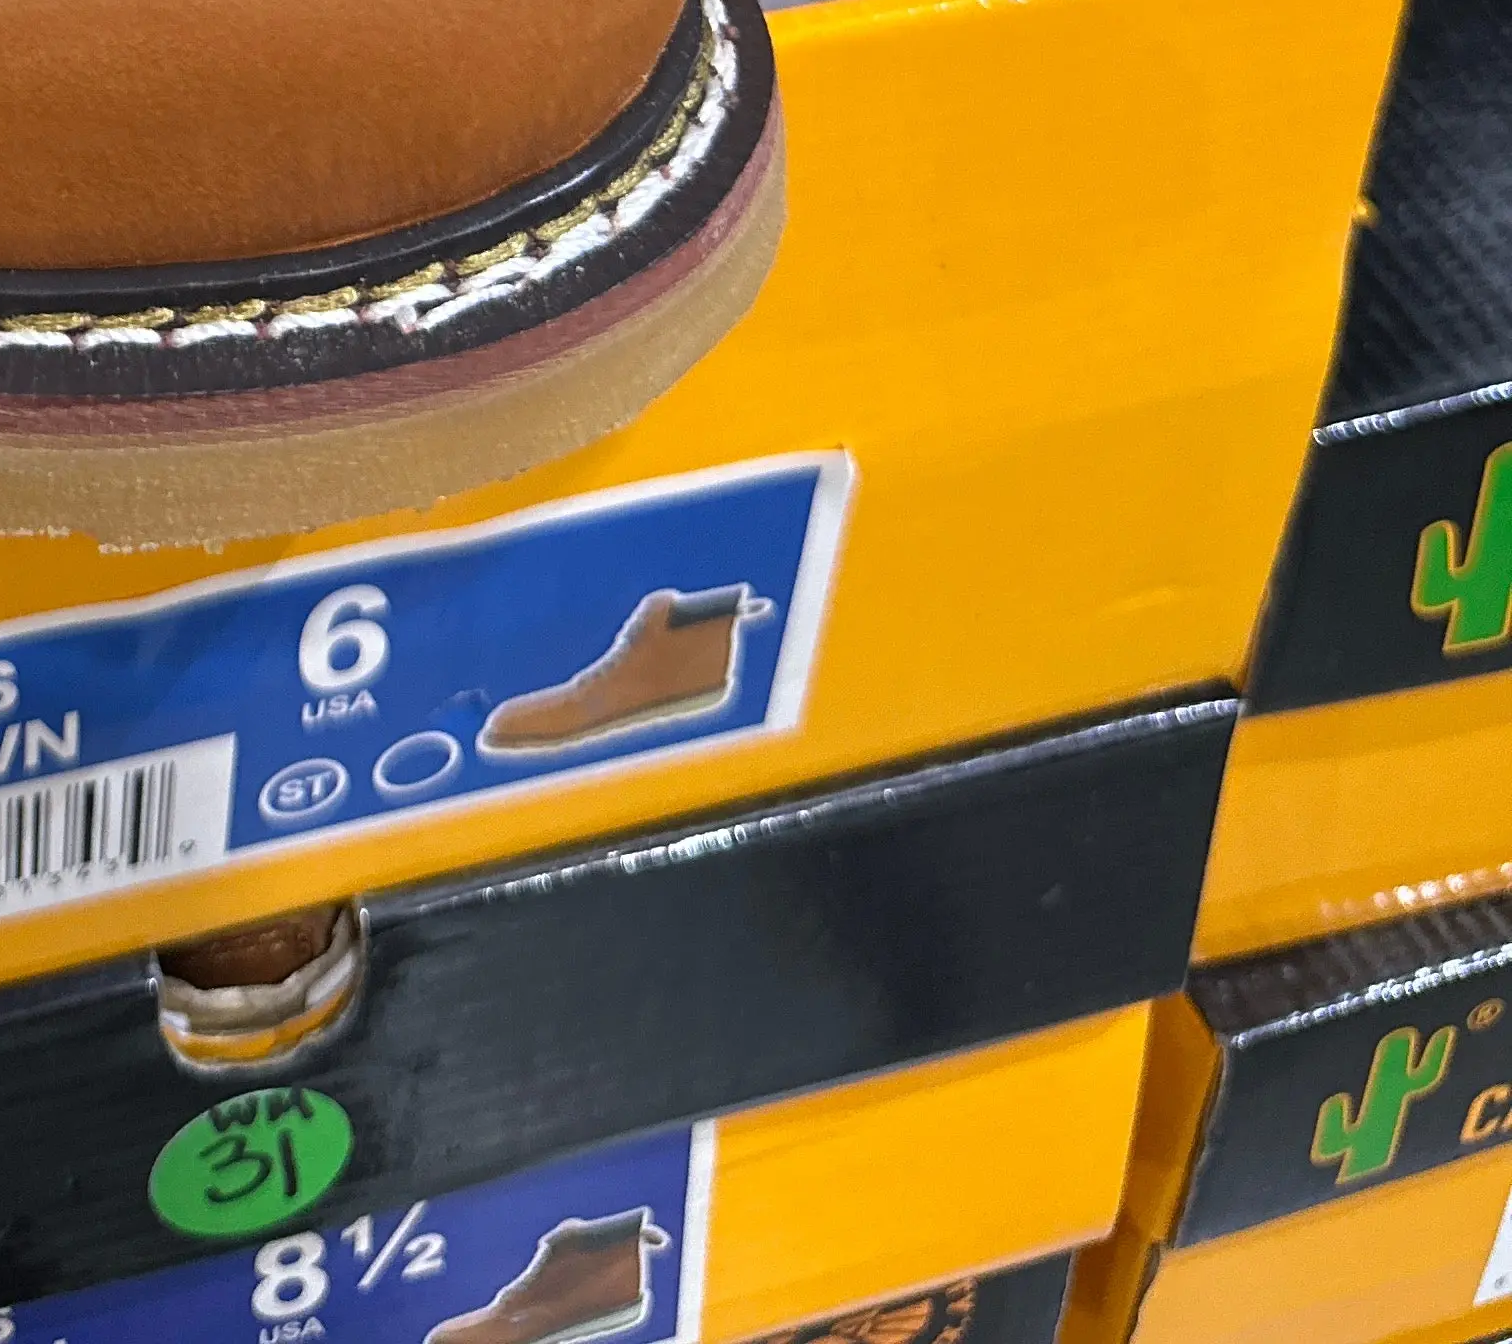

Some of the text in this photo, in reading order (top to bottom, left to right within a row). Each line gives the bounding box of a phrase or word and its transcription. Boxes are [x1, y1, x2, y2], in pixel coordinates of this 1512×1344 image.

[299, 582, 392, 692] 6
[301, 689, 377, 725] USA
[276, 773, 330, 803] ST
[258, 1315, 327, 1344] USA
